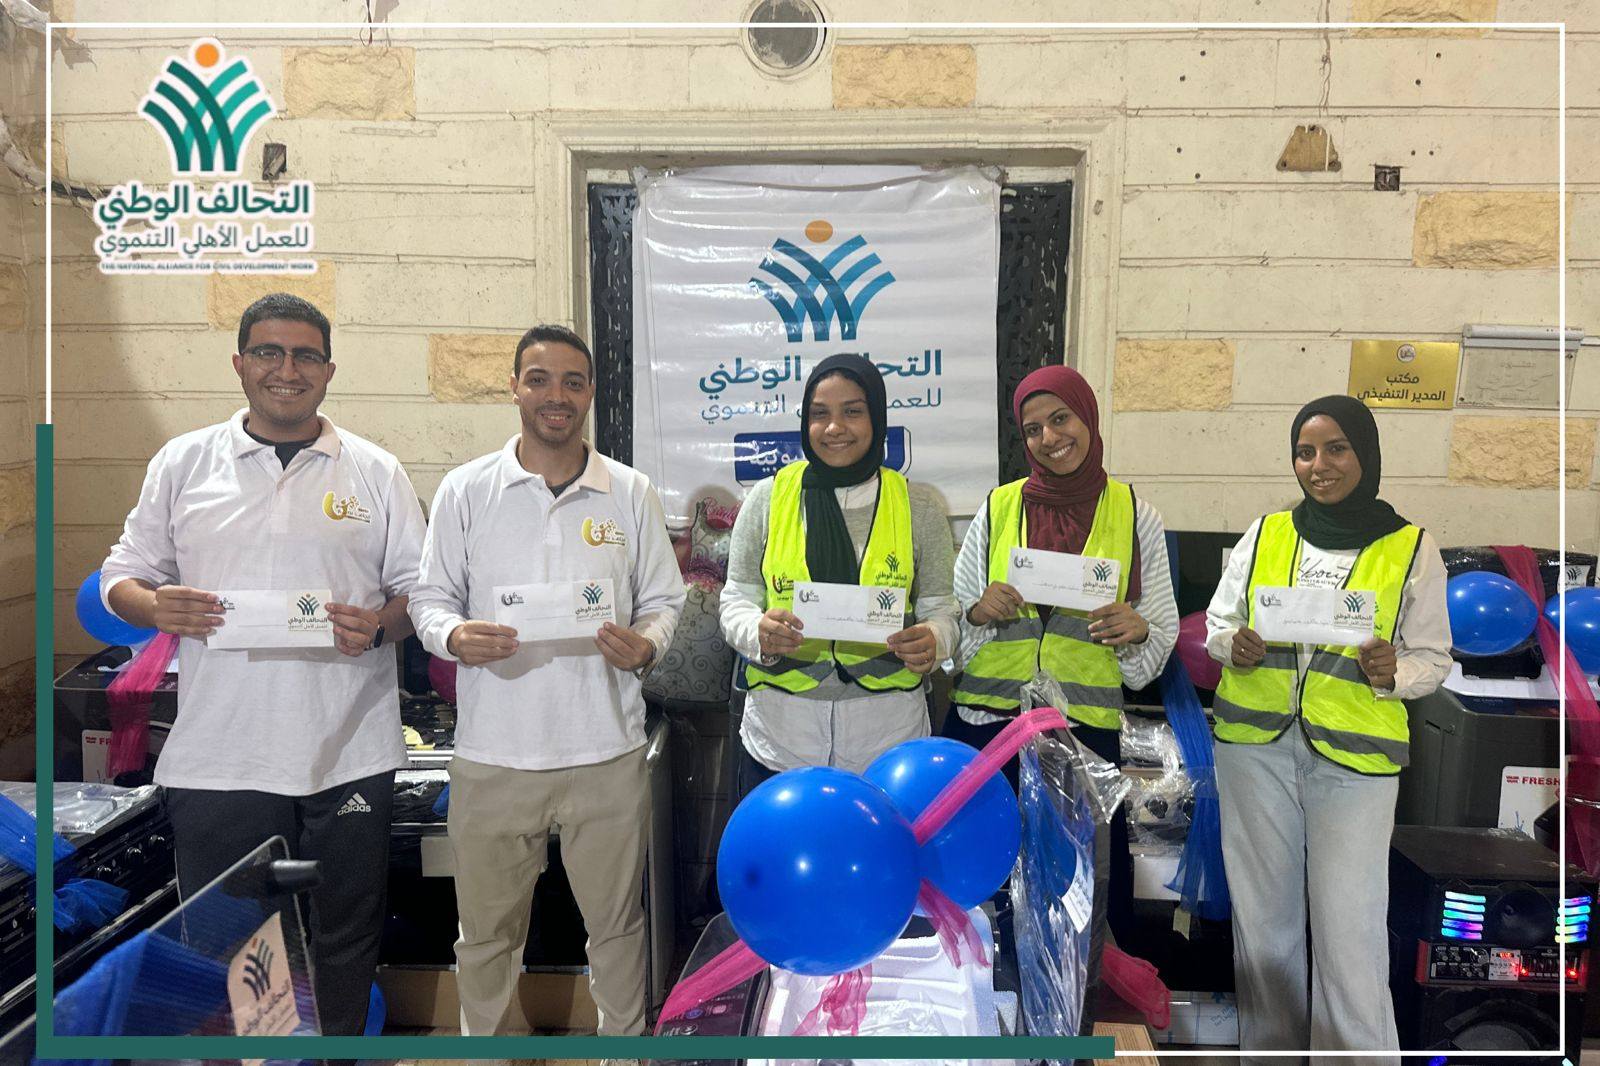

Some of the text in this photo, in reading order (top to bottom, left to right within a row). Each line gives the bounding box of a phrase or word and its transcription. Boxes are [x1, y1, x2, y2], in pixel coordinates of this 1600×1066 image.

[699, 354, 802, 400] الوطني
[1386, 372, 1420, 386] مكتب
[885, 387, 942, 409] للعم
[1411, 391, 1446, 403] المدير
[1521, 775, 1560, 786] FRESH
[337, 804, 371, 816] adidas
